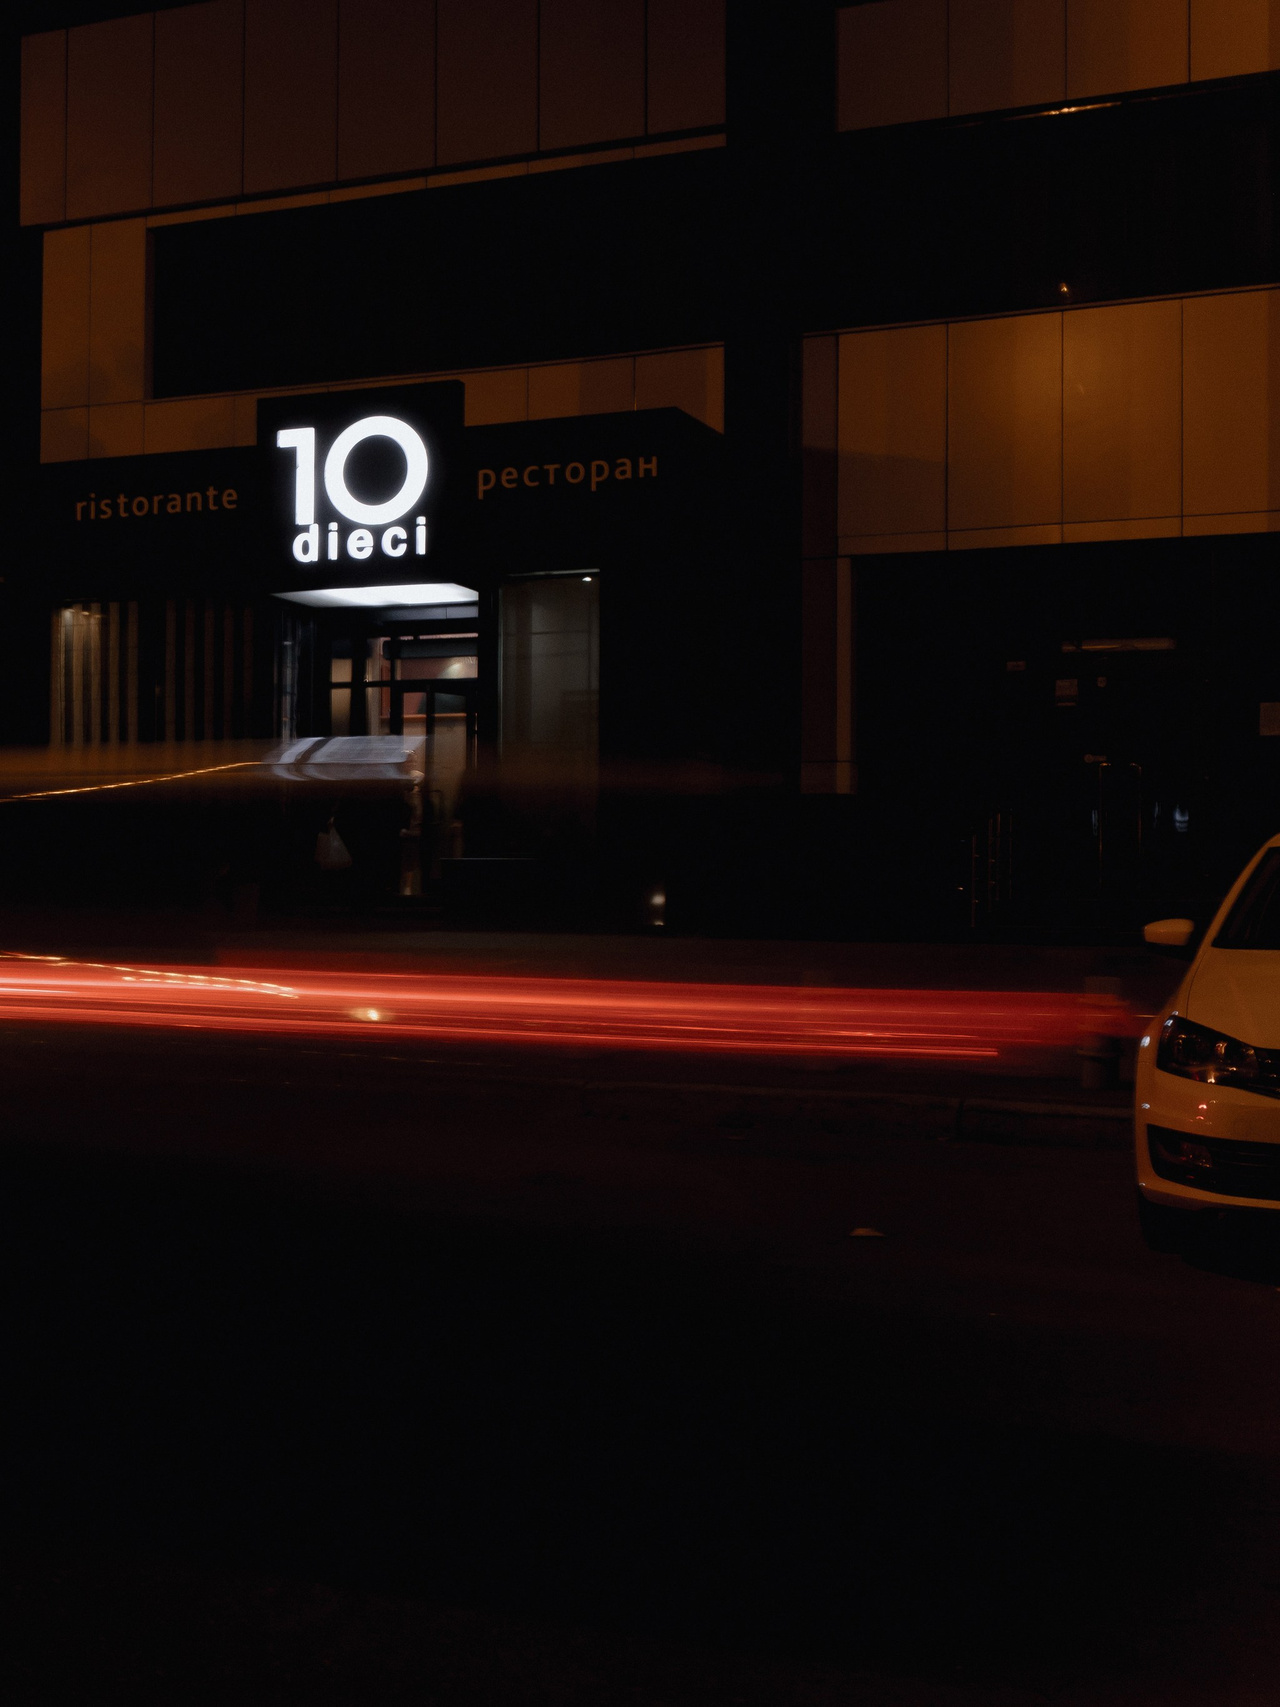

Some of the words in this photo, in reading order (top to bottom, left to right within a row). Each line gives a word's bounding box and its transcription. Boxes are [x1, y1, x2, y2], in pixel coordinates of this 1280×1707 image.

[276, 415, 429, 526] 10
[477, 455, 659, 501] ресторан
[75, 486, 239, 521] ristorante
[292, 515, 427, 562] dieci
